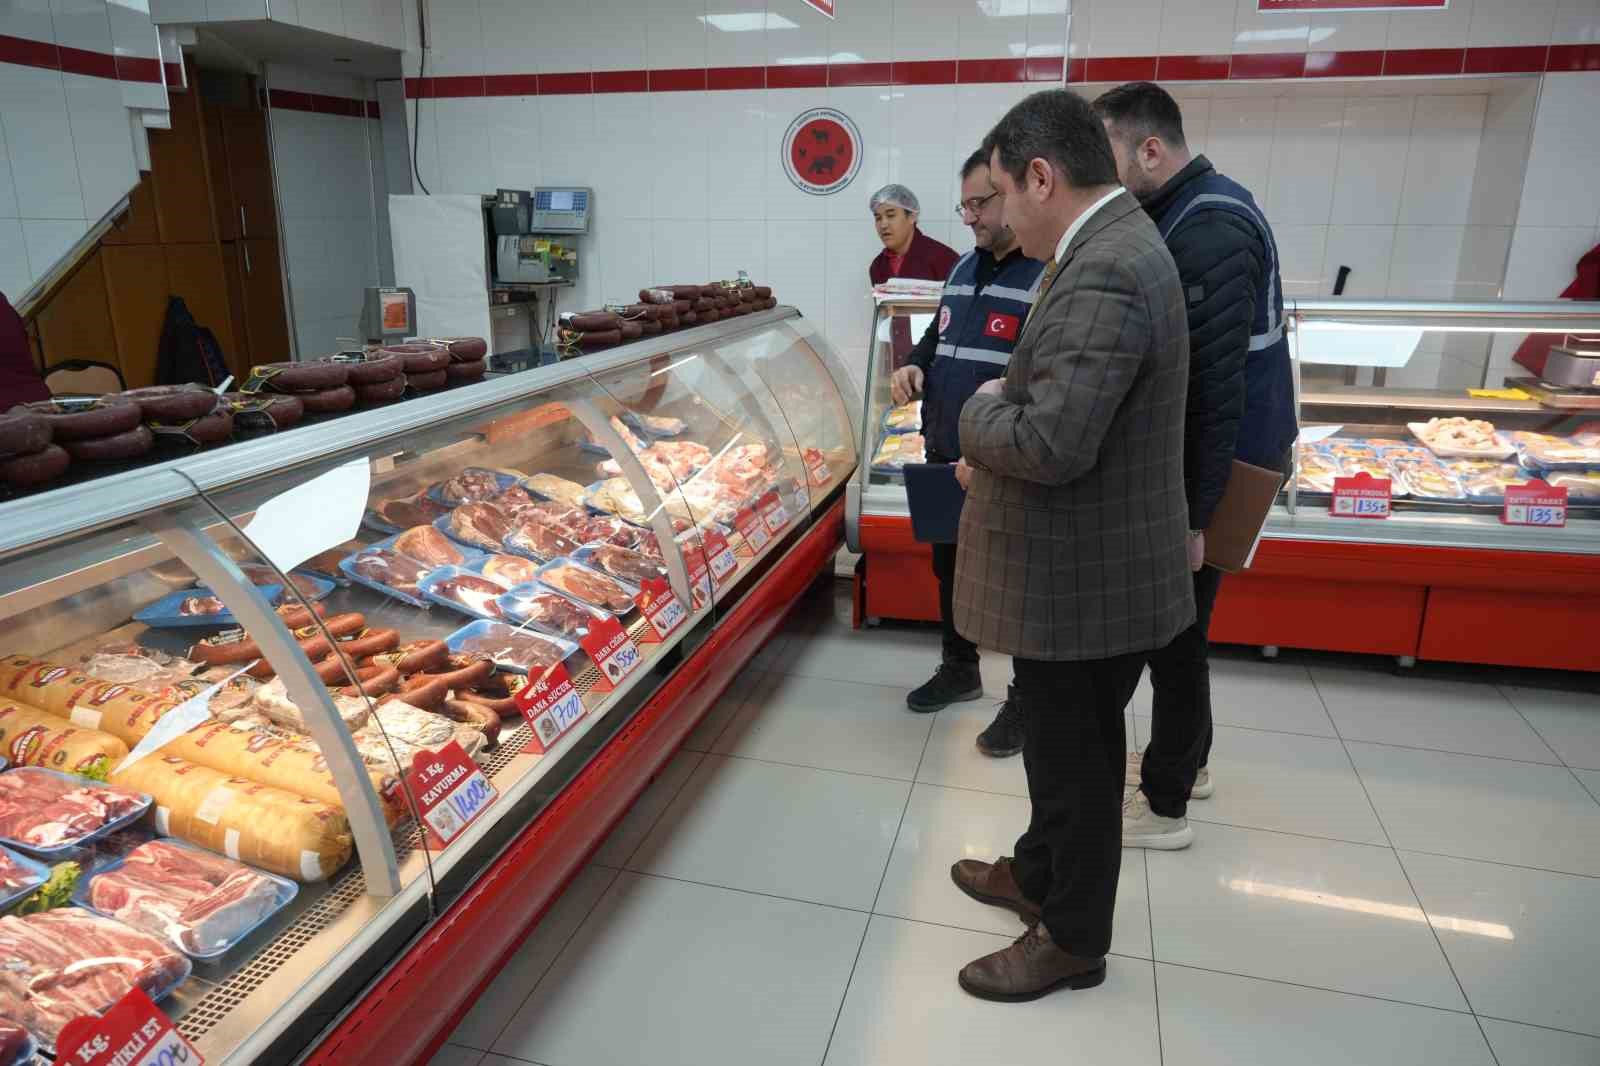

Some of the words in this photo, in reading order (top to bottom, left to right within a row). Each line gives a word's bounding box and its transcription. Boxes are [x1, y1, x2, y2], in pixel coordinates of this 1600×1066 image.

[526, 699, 549, 719] DANA
[553, 694, 579, 728] 700
[419, 773, 429, 784] 1
[426, 762, 445, 777] Kg.
[421, 764, 468, 806] KAVURMA
[141, 1017, 162, 1041] ET
[77, 1033, 111, 1063] Kg.
